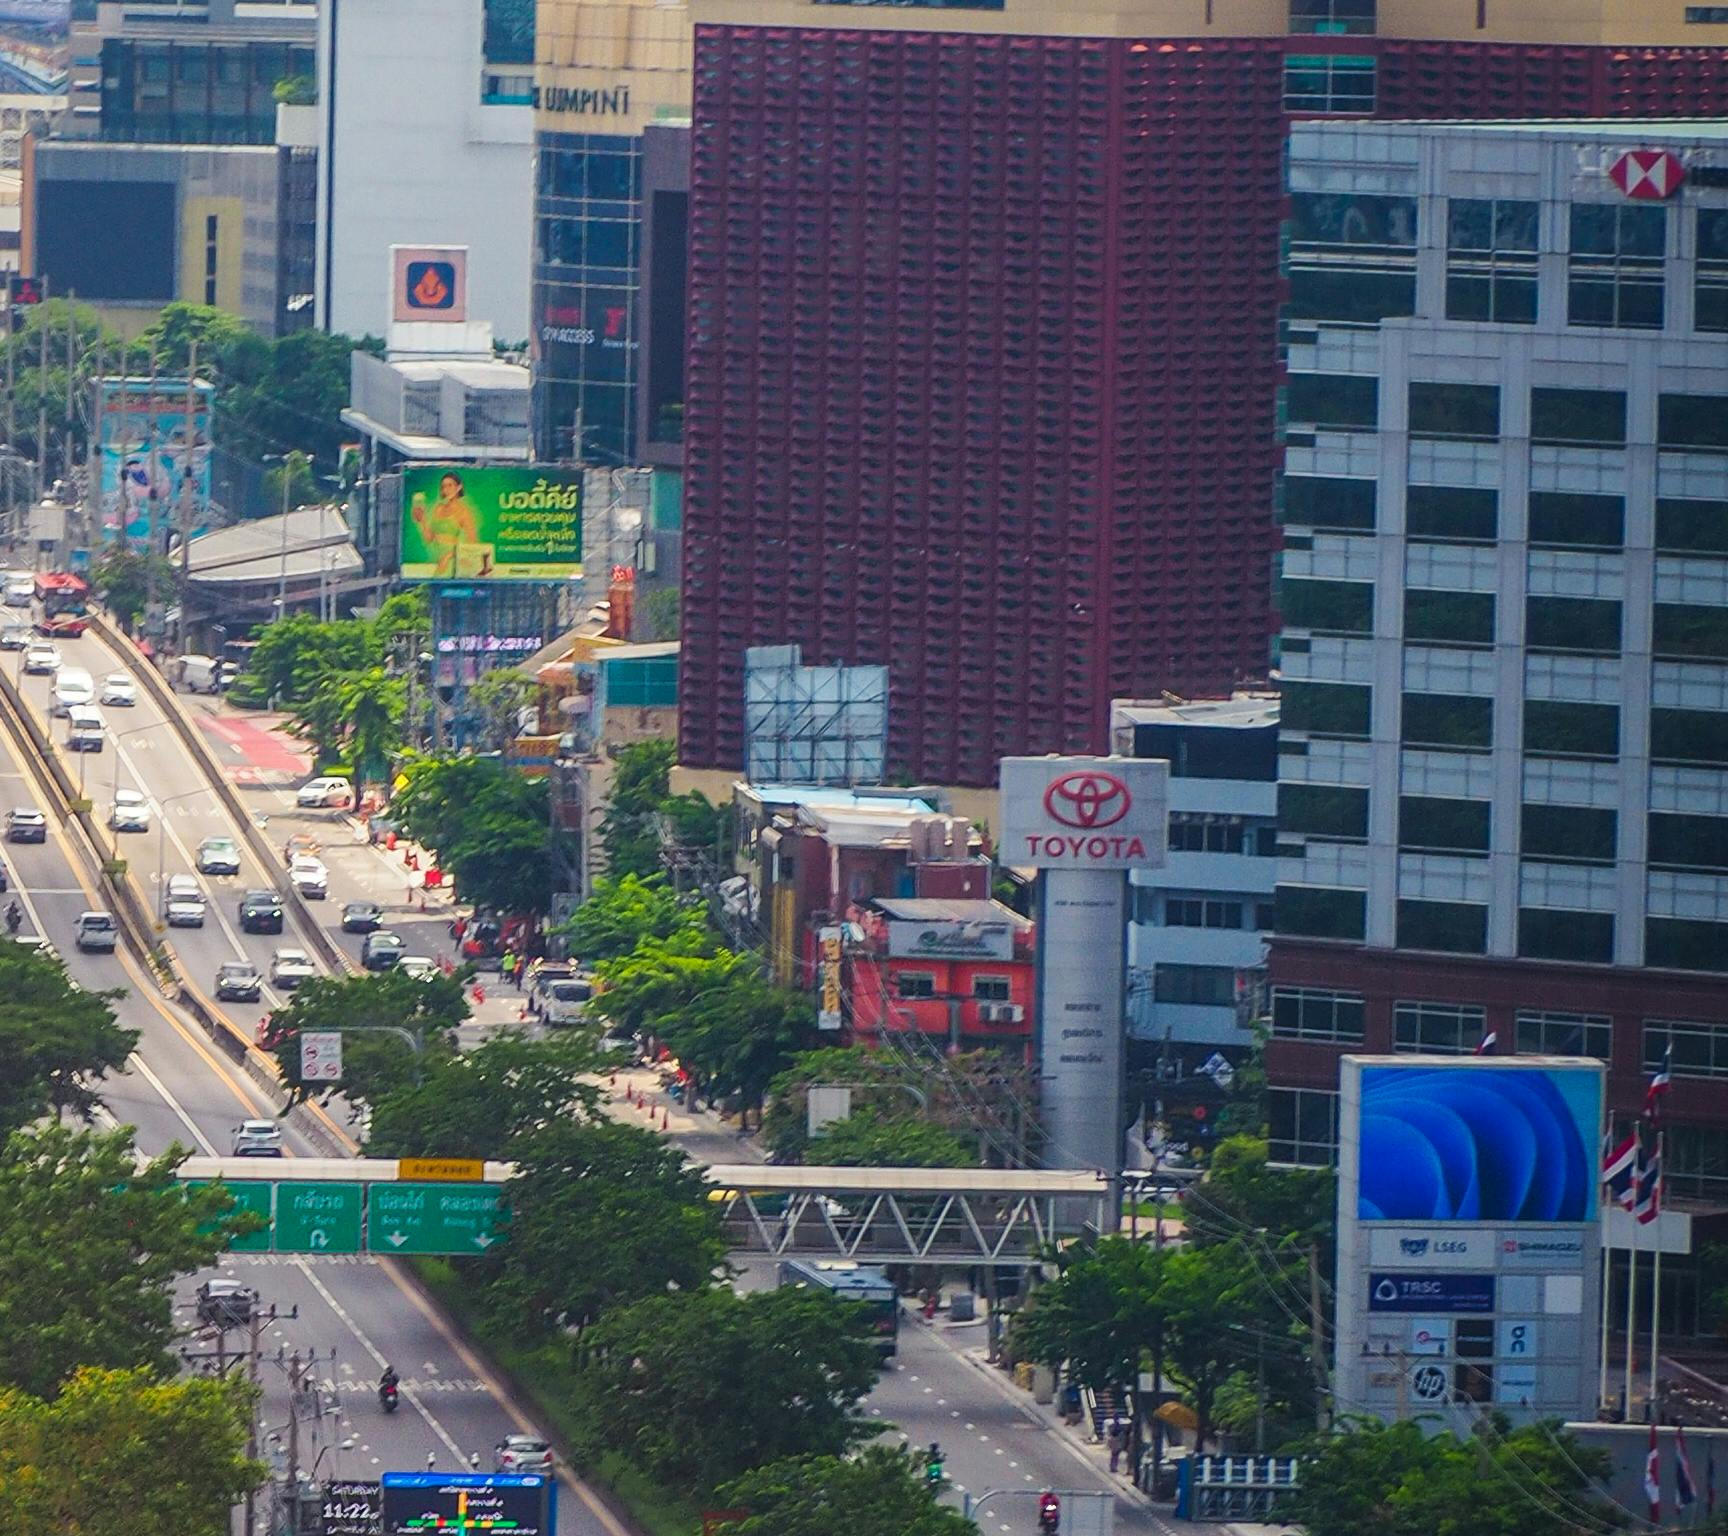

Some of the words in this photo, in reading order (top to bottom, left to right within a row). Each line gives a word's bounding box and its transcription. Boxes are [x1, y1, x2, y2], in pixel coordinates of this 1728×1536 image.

[498, 478, 578, 510] บอดี้คีย์
[1025, 835, 1146, 859] TOYOTA
[1432, 1241, 1468, 1254] LSEG
